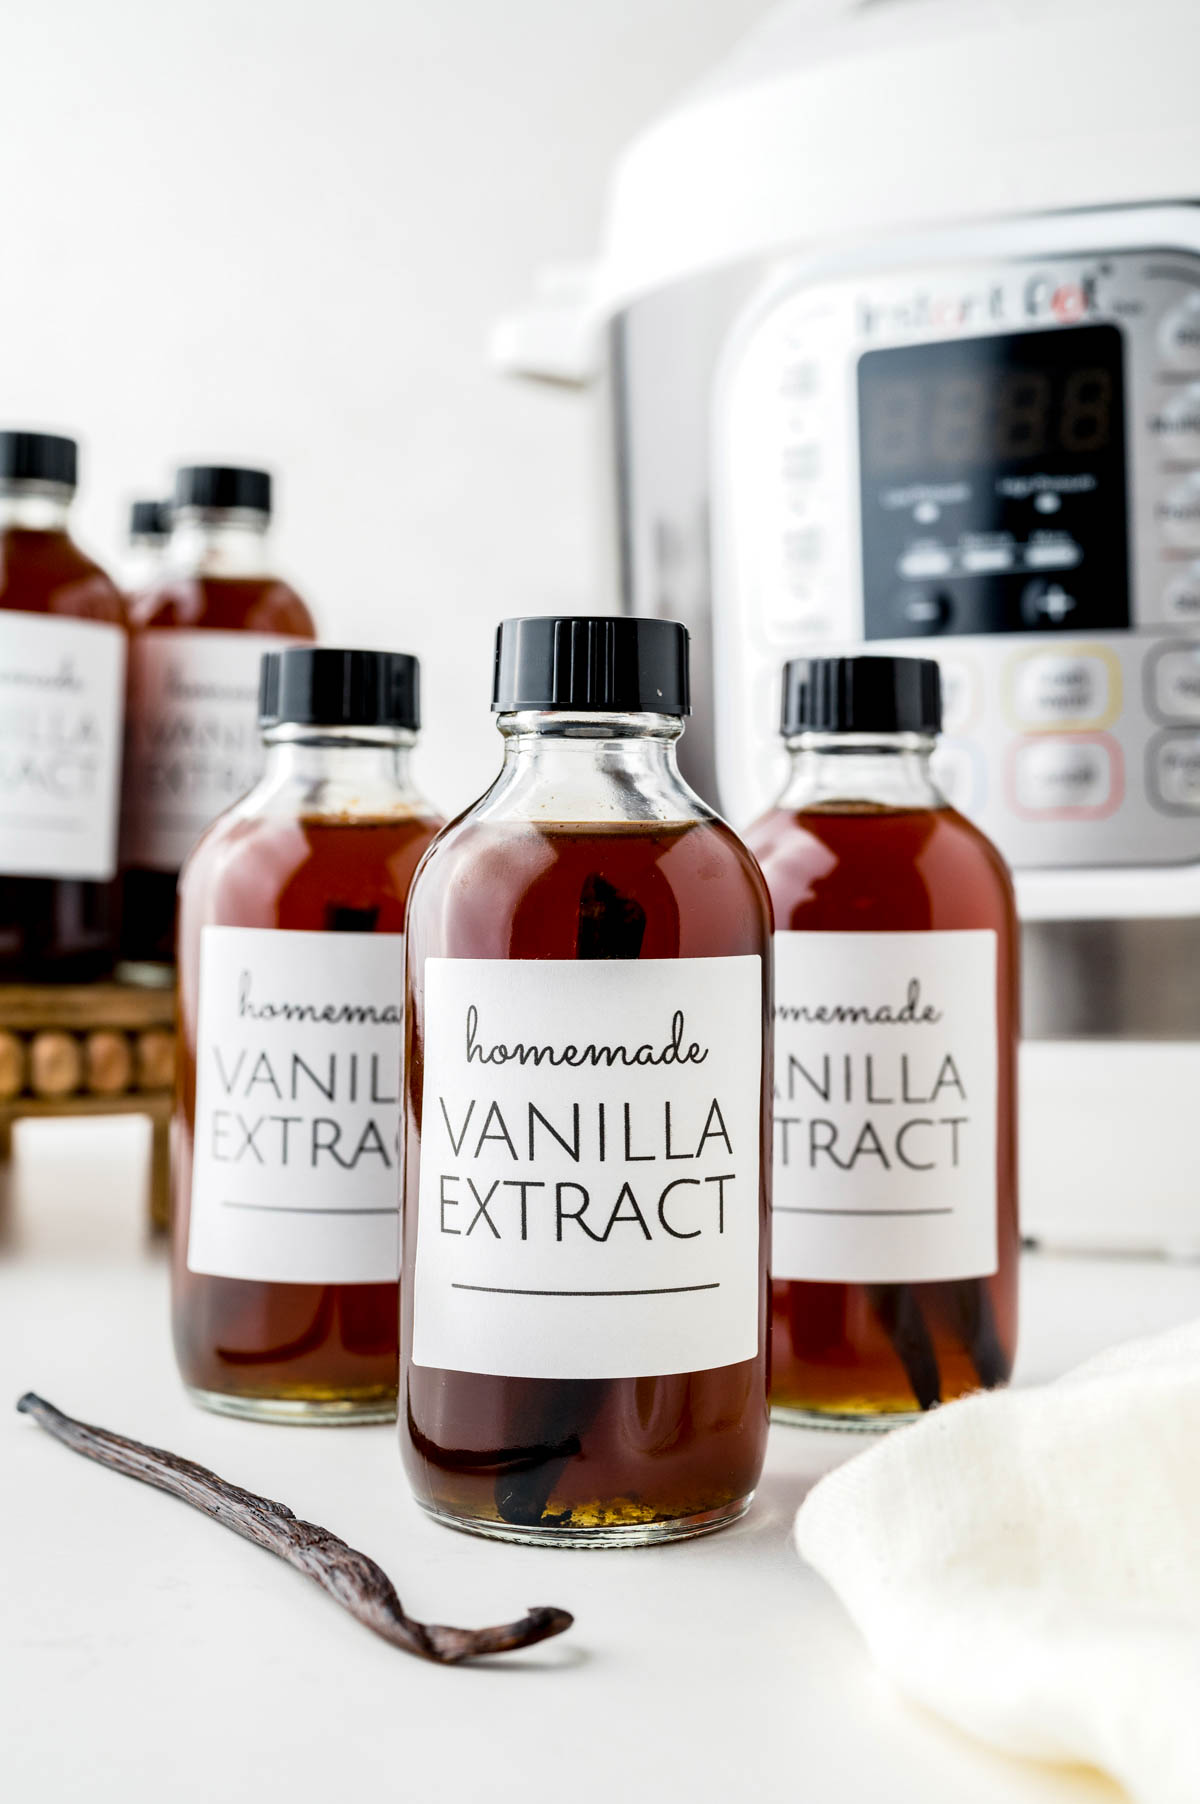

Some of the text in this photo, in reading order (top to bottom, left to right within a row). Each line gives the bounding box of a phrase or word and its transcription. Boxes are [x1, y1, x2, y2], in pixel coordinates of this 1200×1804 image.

[465, 1005, 709, 1066] homemade
[774, 1052, 968, 1105] NILLA
[211, 1109, 400, 1170] EXTRA
[438, 1096, 734, 1162] VANILLA
[439, 1174, 737, 1243] EXTRACT
